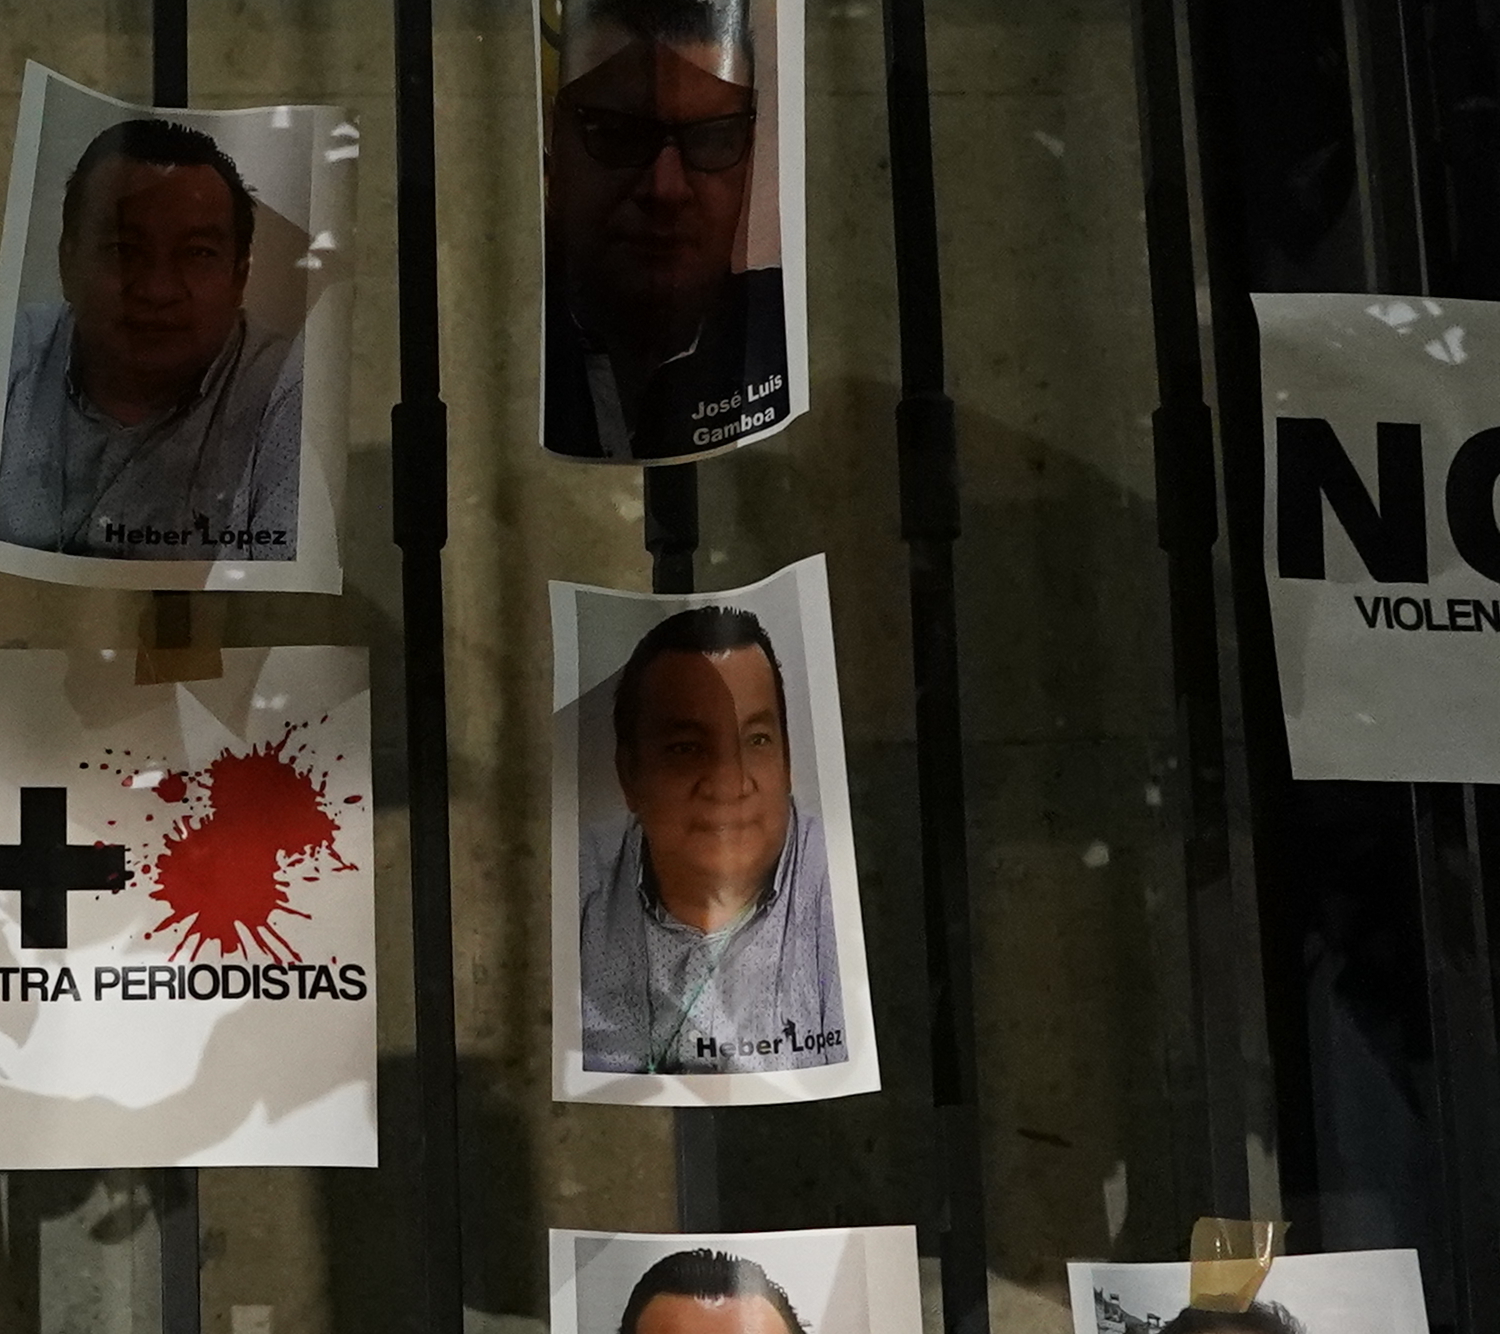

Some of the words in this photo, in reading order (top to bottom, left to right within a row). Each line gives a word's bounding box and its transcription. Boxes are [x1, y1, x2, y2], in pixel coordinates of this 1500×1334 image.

[691, 389, 742, 421] José
[747, 373, 783, 403] Luis
[693, 406, 776, 446] Gamboa
[105, 523, 192, 545] Heber
[201, 524, 287, 549] López
[93, 963, 368, 1002] PERIODISTAS
[696, 1037, 783, 1059] Heber
[790, 1028, 843, 1055] López
